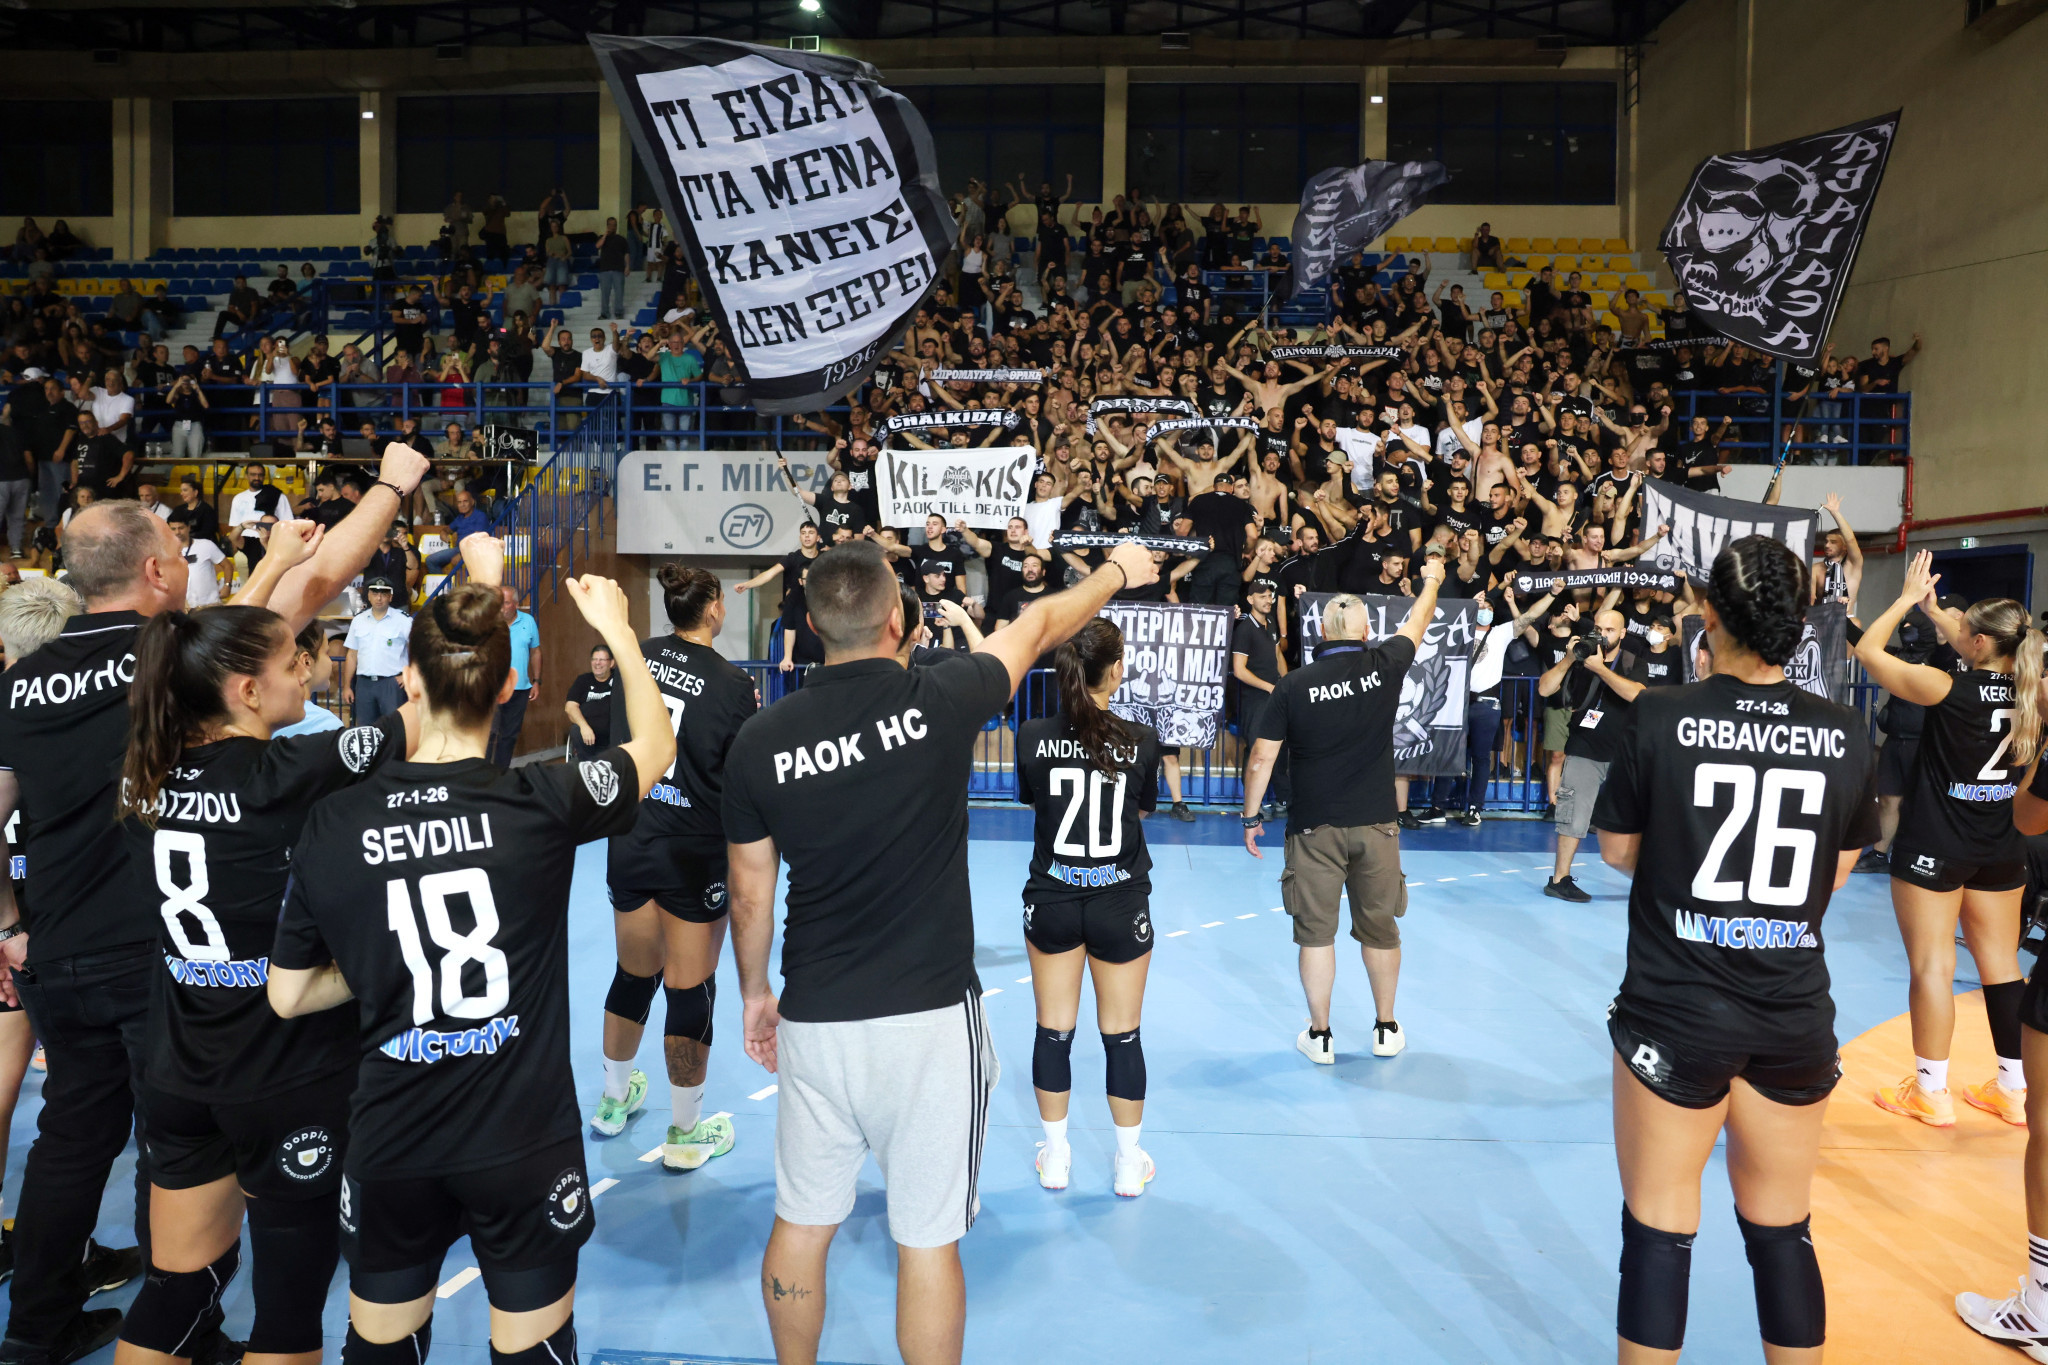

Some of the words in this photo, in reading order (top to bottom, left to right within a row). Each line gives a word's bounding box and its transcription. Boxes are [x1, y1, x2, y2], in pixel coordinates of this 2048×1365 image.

[650, 98, 707, 151] ΤΙ
[679, 170, 755, 220] ΓΙΑ
[750, 136, 895, 210] ΜΕΝΑ
[705, 197, 914, 285] ΚΑΝΕΙΣ
[734, 300, 809, 349] ΔΕΝ
[809, 252, 932, 334] ΞΕΡΕΙ
[822, 340, 880, 391] 1926
[1271, 346, 1323, 359] ΕΠΑΝΟΜΗ
[1009, 370, 1043, 381] ΘΡΑΚΗ
[888, 411, 1002, 431] CHALKIDA
[975, 453, 1028, 502] KIS
[893, 501, 935, 515] PAOK
[939, 501, 971, 515] TILL
[975, 503, 1021, 517] DEATH
[1624, 571, 1659, 586] 1994
[1188, 613, 1228, 647] ΣΤΑ
[661, 648, 688, 663] 27-1-26
[1122, 645, 1178, 681] ΡΦΙΑ
[1183, 648, 1226, 683] ΜΑΣ
[1990, 672, 2016, 681] 27-1-2
[10, 669, 93, 709] PAOK
[94, 653, 136, 691] HC
[1308, 680, 1354, 704] PAOK
[1359, 671, 1382, 693] HC
[1735, 699, 1790, 716] 27-1-26
[773, 732, 866, 785] PAOK
[875, 707, 928, 752] HC
[1035, 739, 1138, 764] ANDROU
[1676, 717, 1846, 759] GRBAVCEVIC
[122, 777, 242, 823] ATZIOU
[386, 786, 449, 808] 27-1-26
[1049, 767, 1127, 859] 20
[362, 812, 494, 865] SEVDILI
[1691, 762, 1827, 907] 26
[153, 829, 231, 962] 8
[386, 867, 510, 1027] 18
